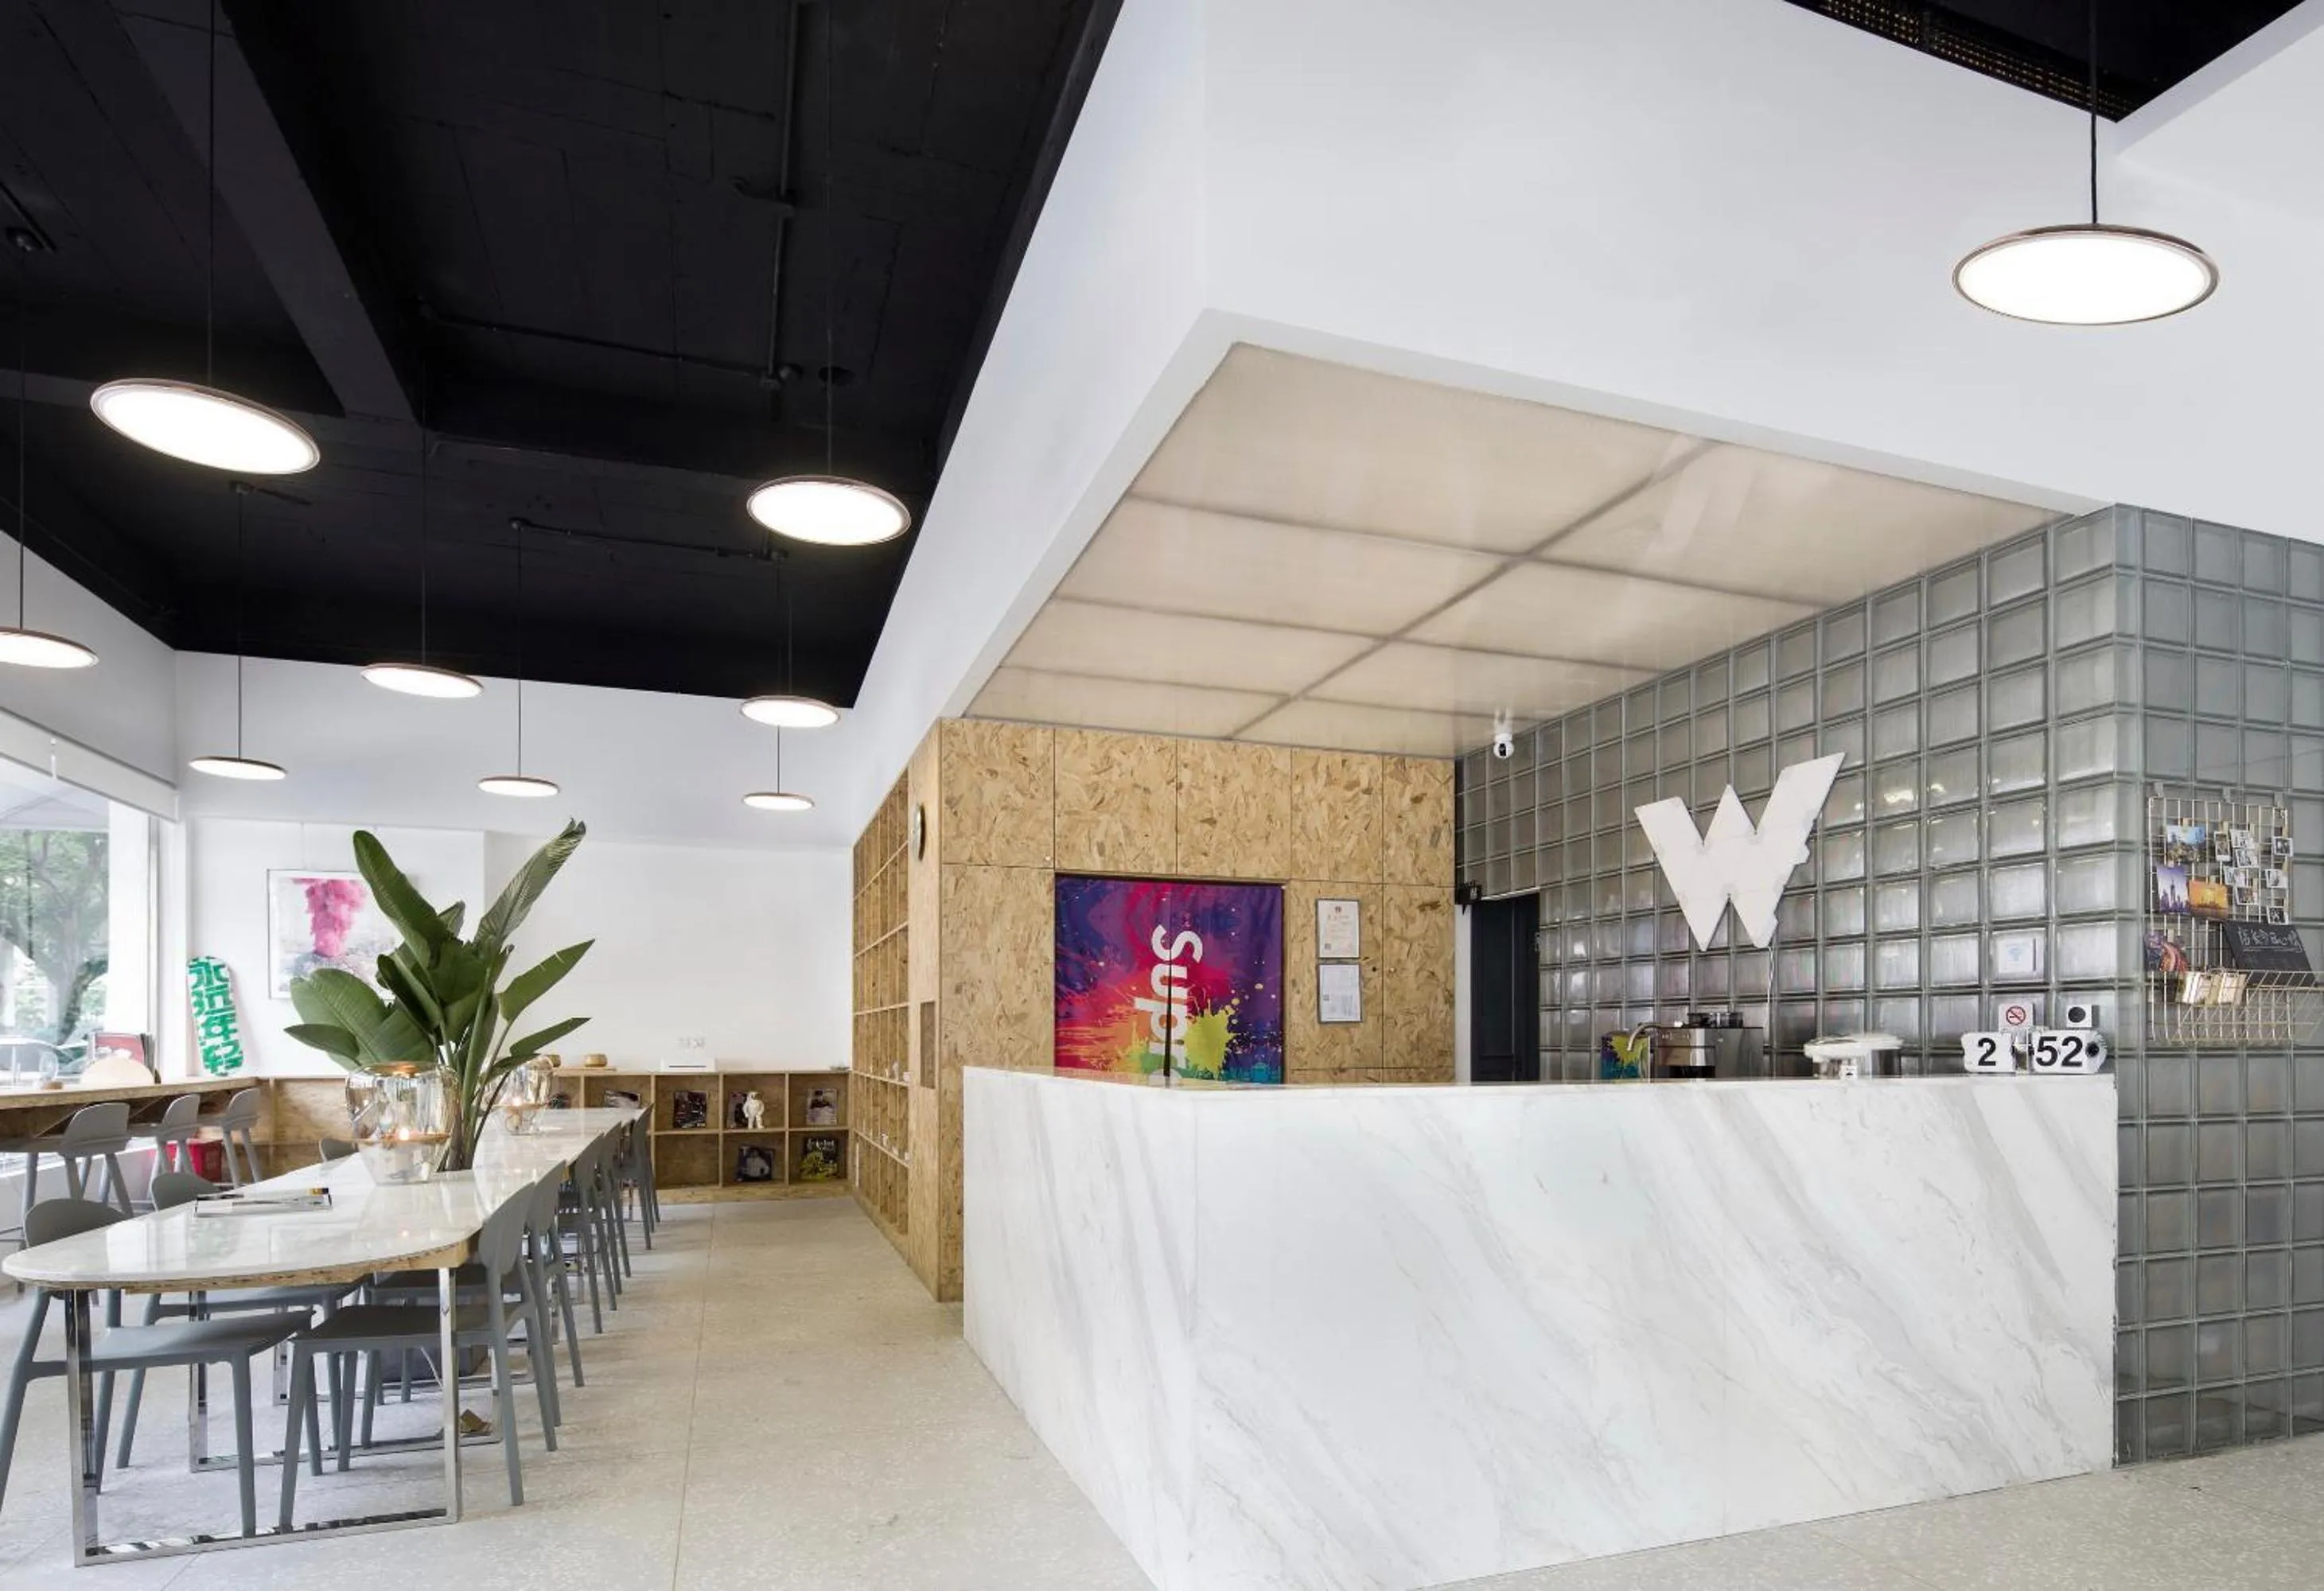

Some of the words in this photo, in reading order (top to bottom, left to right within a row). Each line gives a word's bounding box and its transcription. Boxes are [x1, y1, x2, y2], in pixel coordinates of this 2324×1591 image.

[1633, 752, 1846, 951] W
[1978, 1037, 1996, 1067] 2
[2035, 1036, 2083, 1067] 52
